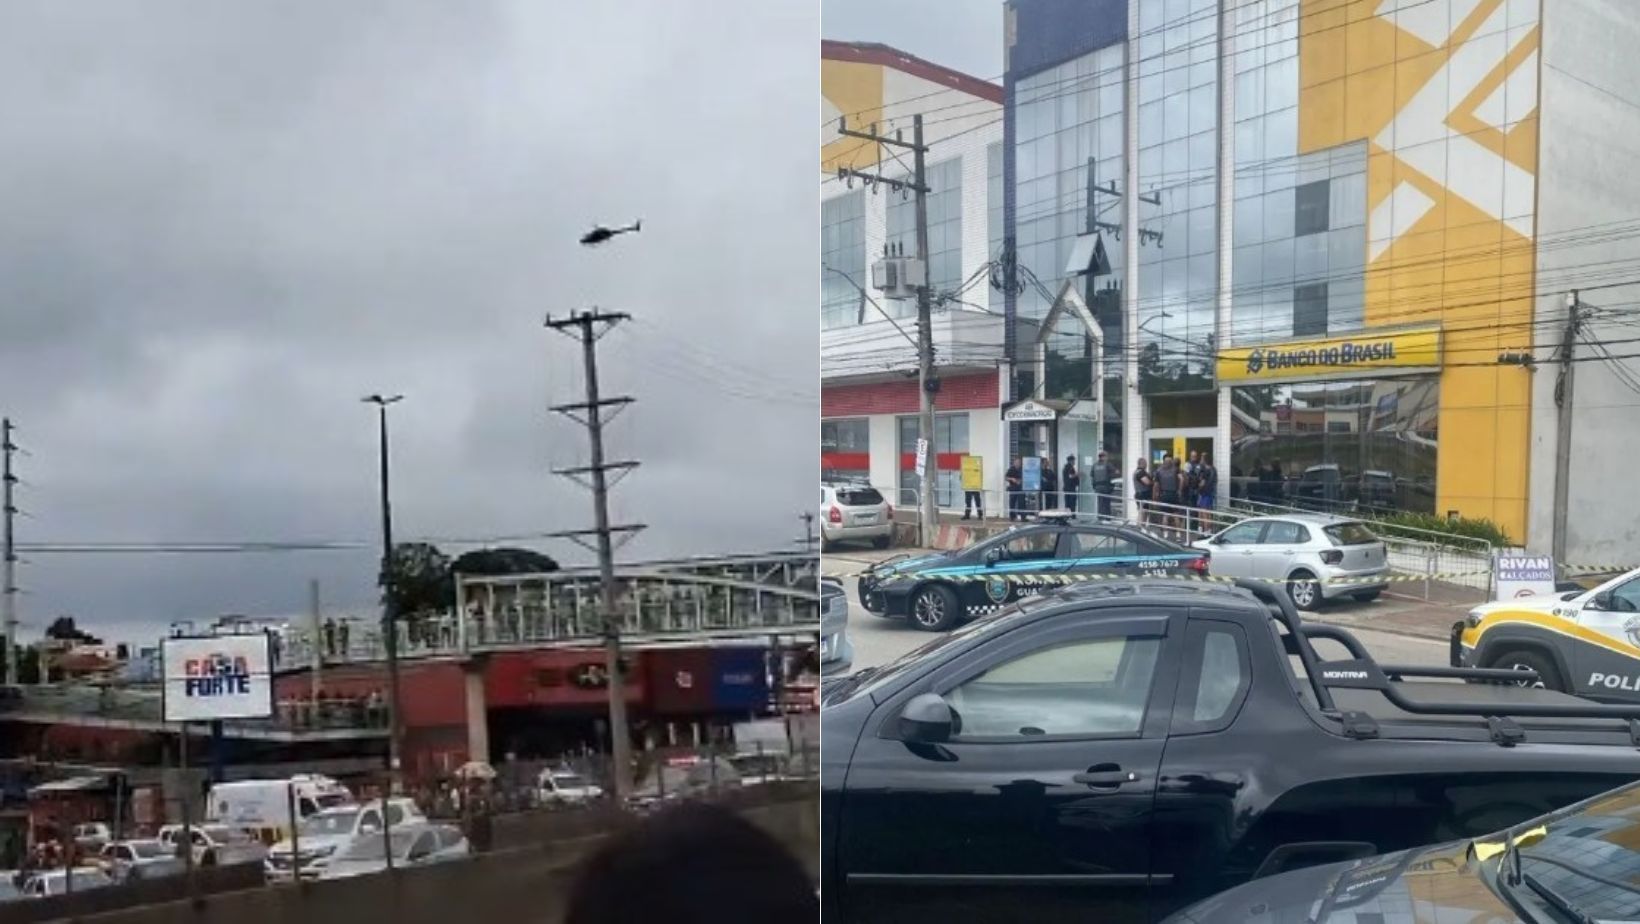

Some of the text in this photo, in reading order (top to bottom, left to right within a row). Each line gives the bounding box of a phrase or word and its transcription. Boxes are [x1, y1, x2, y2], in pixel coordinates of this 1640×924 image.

[1267, 342, 1397, 370] BANCO DO BRASIL
[1499, 558, 1550, 570] RIVAN
[186, 656, 248, 676] CASA
[186, 675, 250, 697] FORTE
